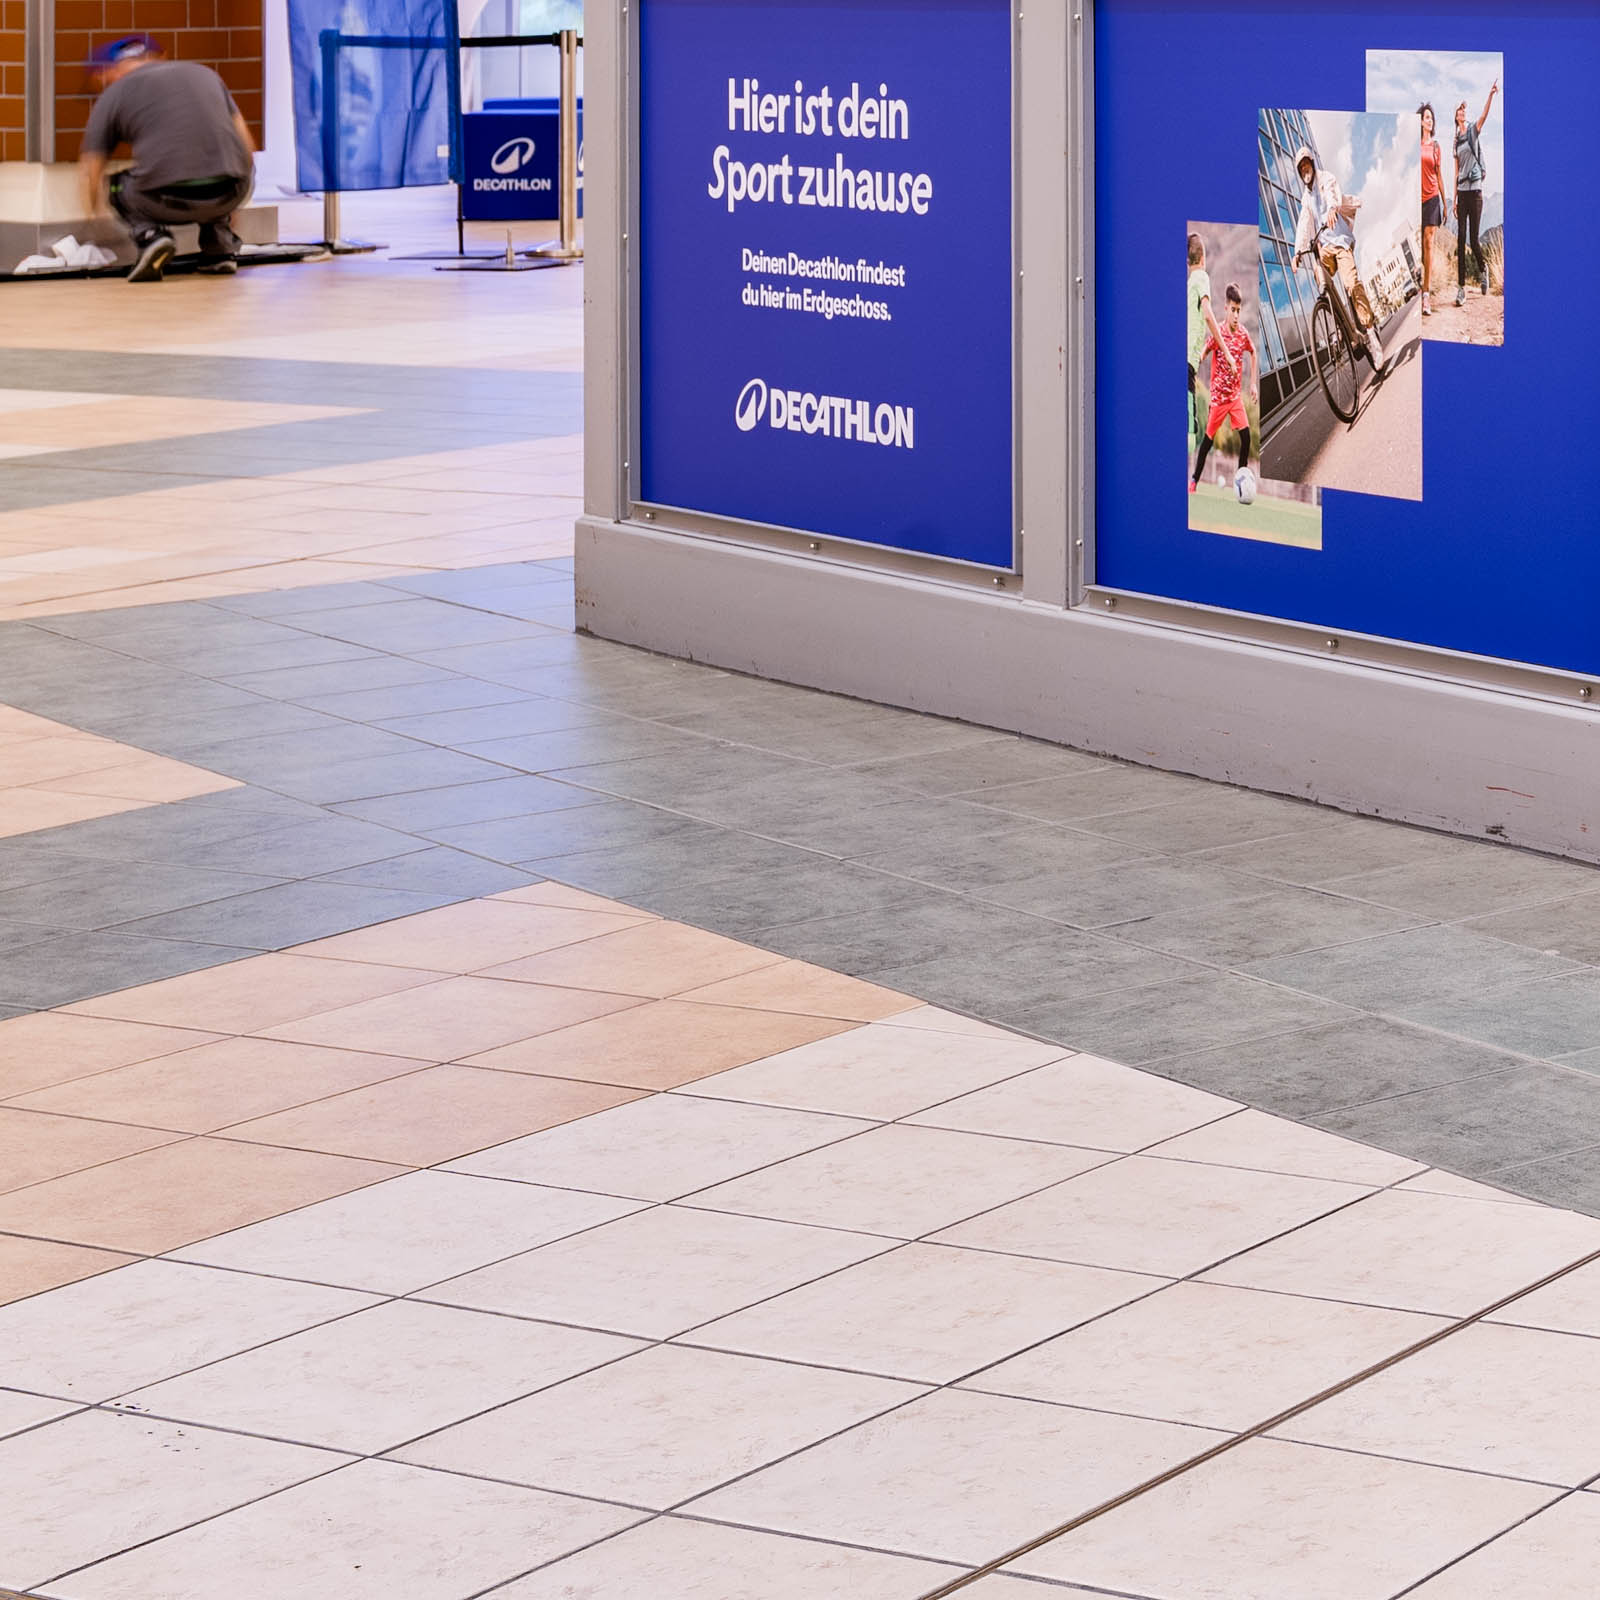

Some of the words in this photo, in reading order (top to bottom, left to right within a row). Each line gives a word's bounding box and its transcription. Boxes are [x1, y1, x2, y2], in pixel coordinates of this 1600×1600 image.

[728, 78, 790, 133] Hier
[794, 80, 833, 136] ist
[837, 82, 909, 139] dein
[473, 178, 552, 191] DECATHLON
[708, 145, 793, 212] Sport
[798, 153, 933, 215] zuhause
[742, 248, 787, 275] Deinen
[788, 252, 855, 282] Decathlon
[856, 259, 905, 287] findest
[742, 282, 759, 305] du
[760, 283, 785, 309] hier
[786, 286, 801, 311] im
[803, 288, 892, 321] Erdgeschoss.
[770, 387, 915, 449] DECATHLON
